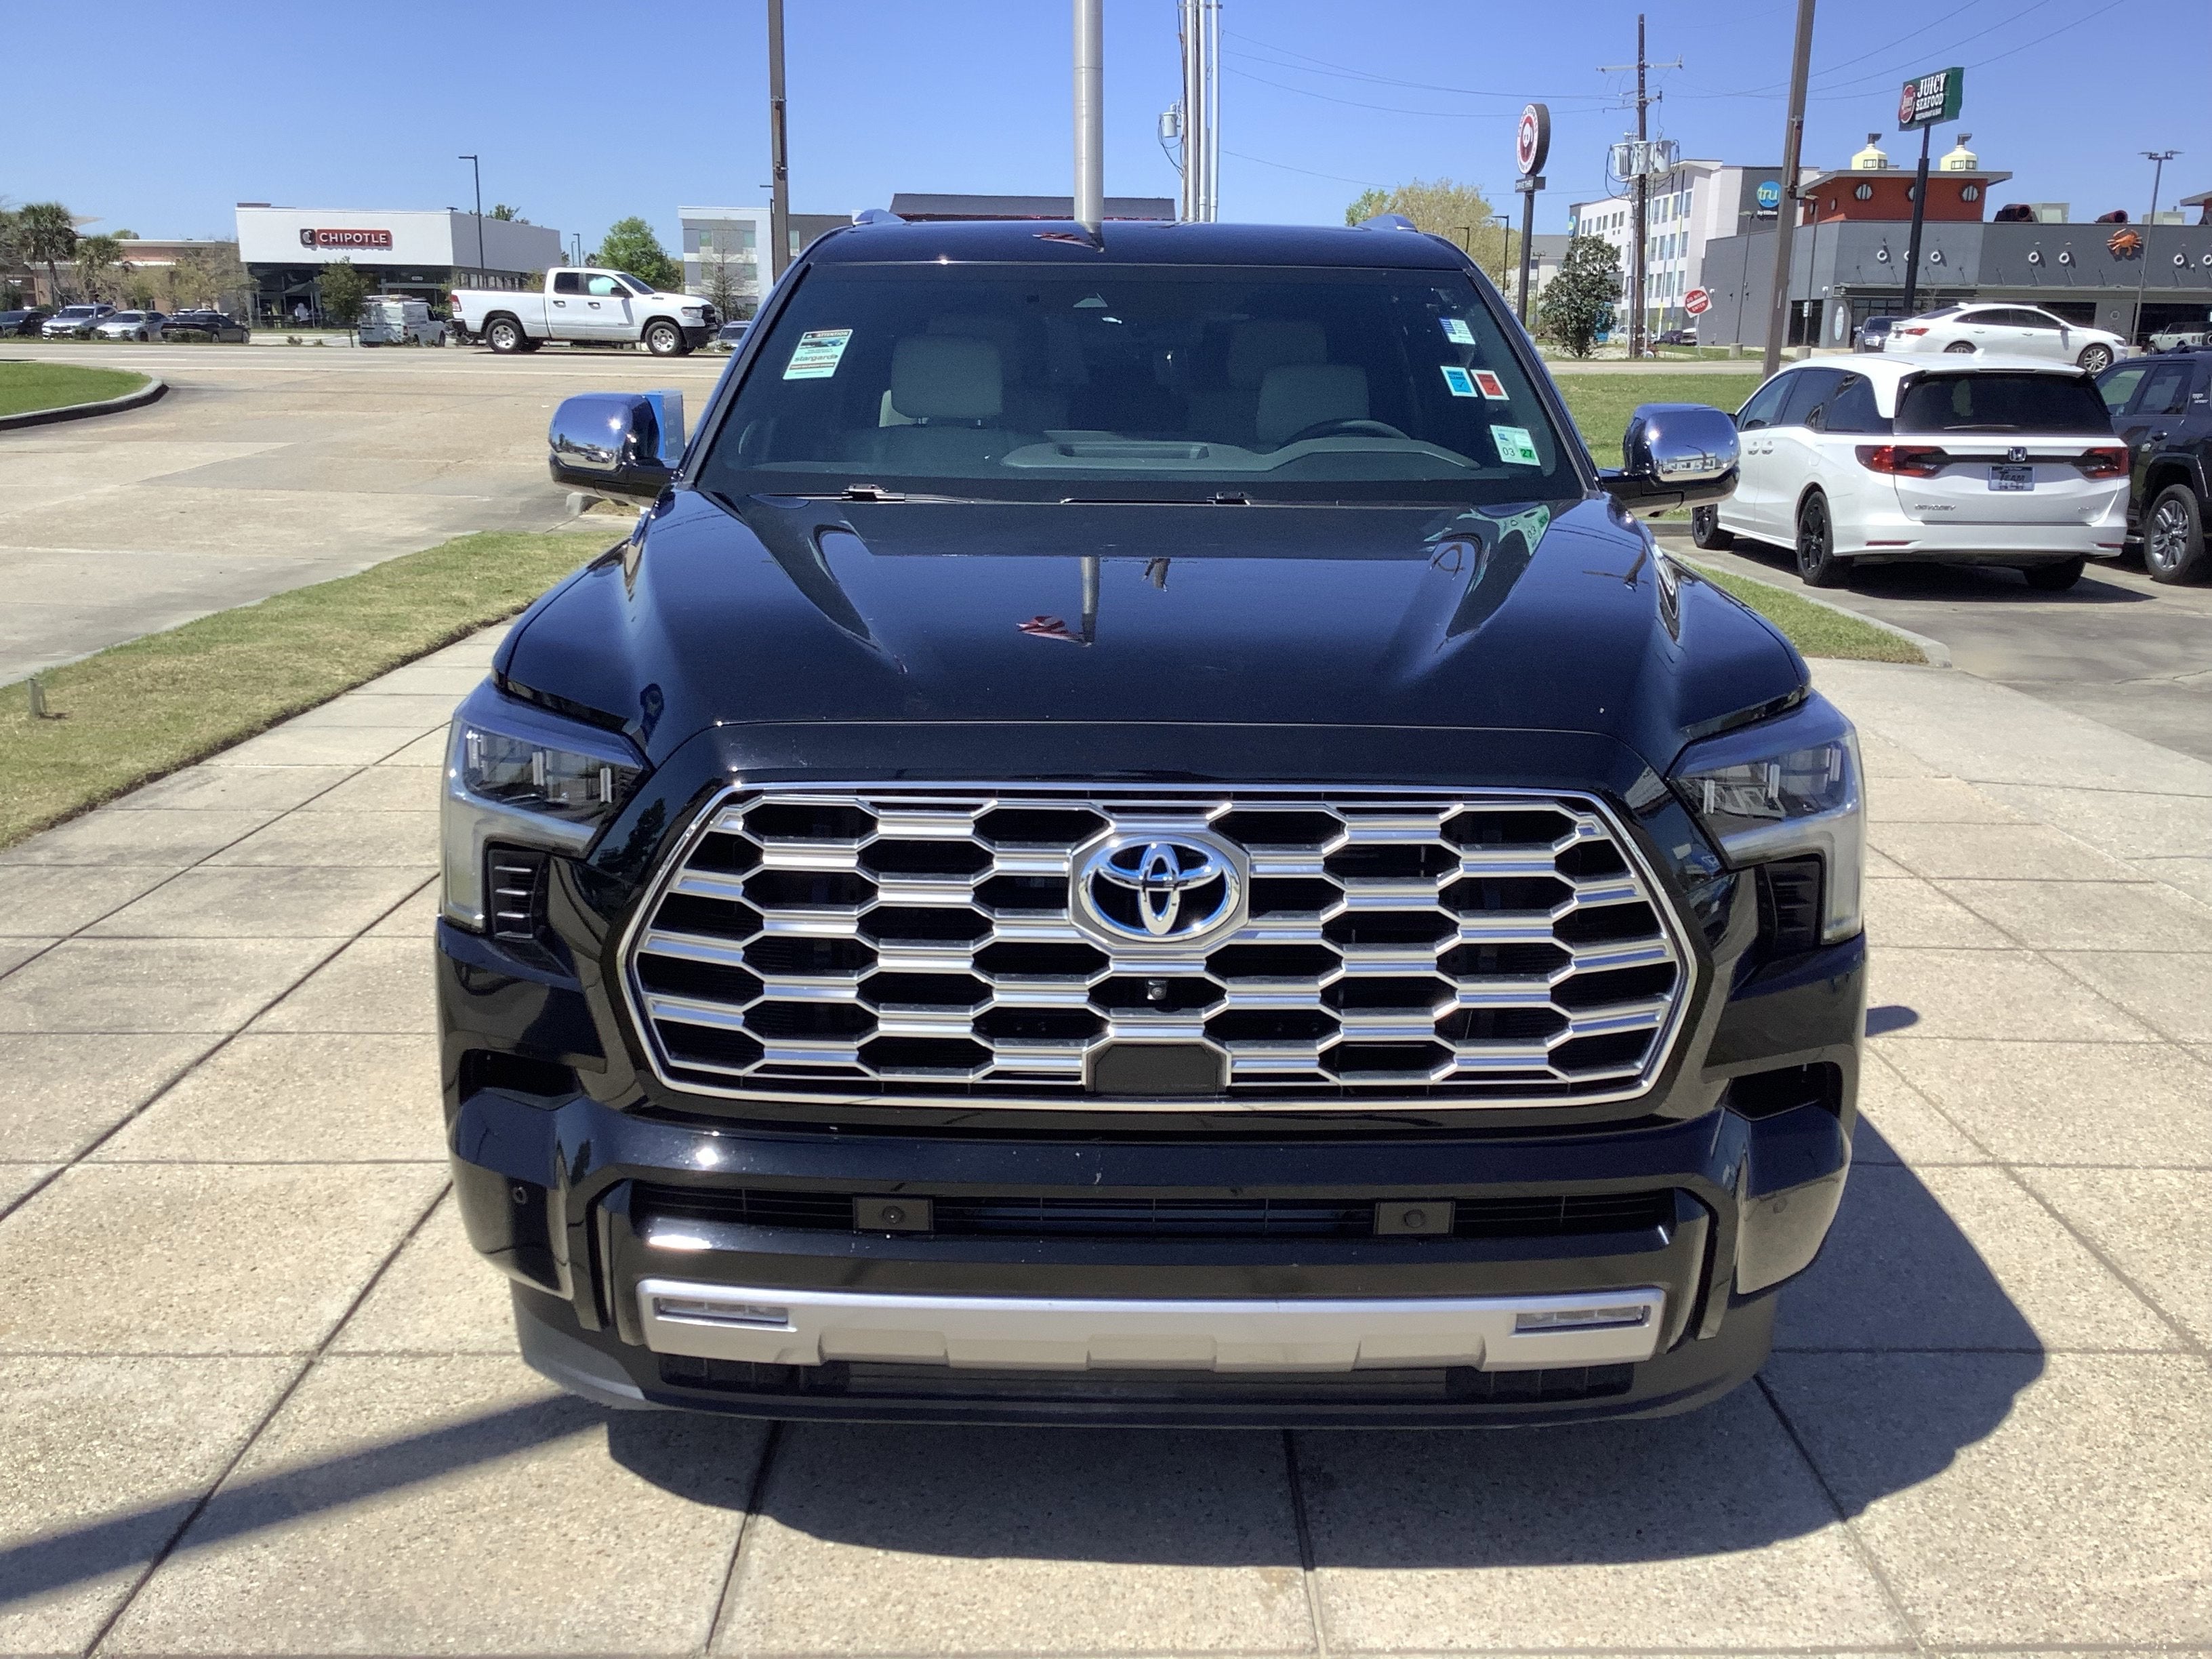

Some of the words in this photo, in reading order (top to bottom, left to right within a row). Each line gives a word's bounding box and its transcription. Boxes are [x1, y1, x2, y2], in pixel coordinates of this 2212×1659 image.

[1917, 73, 1946, 98] JUICY
[1915, 92, 1944, 111] SEAFOOD
[1757, 186, 1778, 201] tru
[319, 232, 388, 243] CHIPOTLE
[1694, 291, 1703, 300] NOT
[1692, 302, 1706, 312] ENTER
[1502, 447, 1515, 457] 03
[1520, 449, 1532, 458] 27
